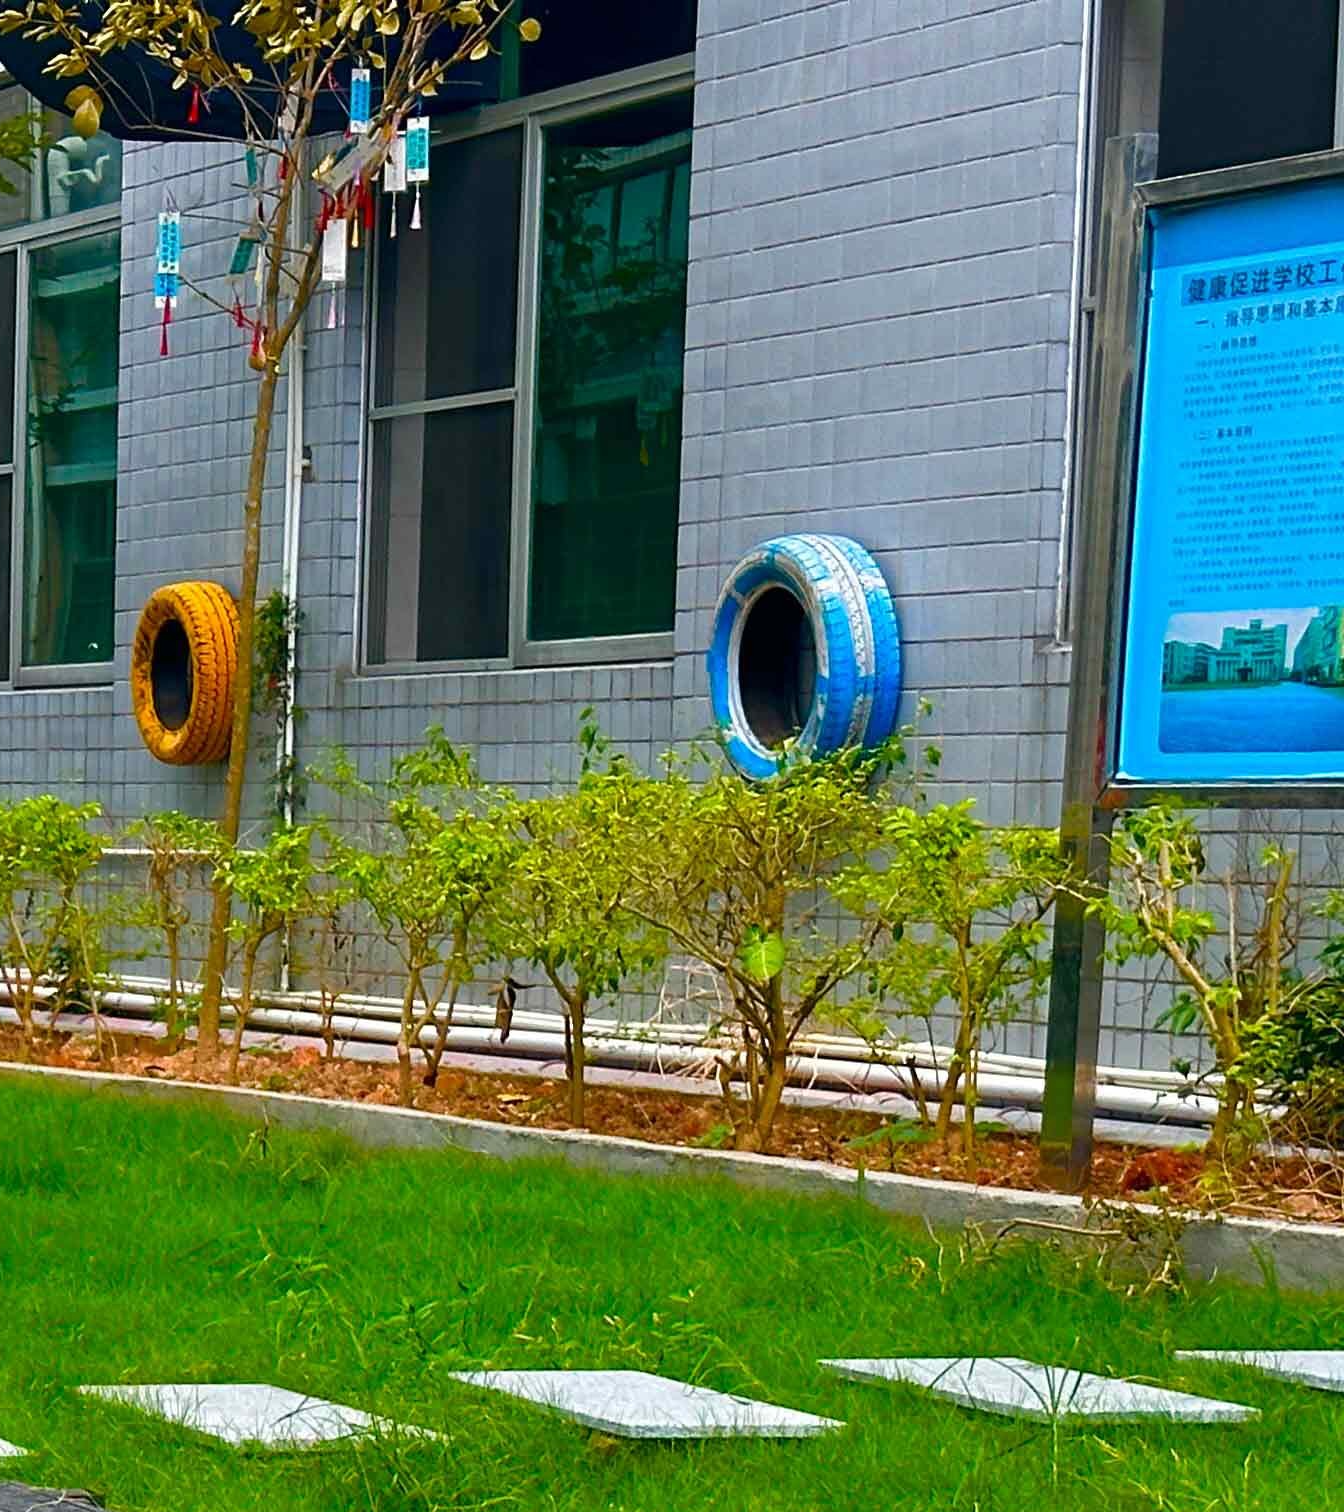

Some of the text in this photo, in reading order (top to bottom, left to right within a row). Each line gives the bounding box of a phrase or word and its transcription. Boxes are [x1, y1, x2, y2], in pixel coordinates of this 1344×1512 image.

[1188, 259, 1344, 303] 健康促进学校工
